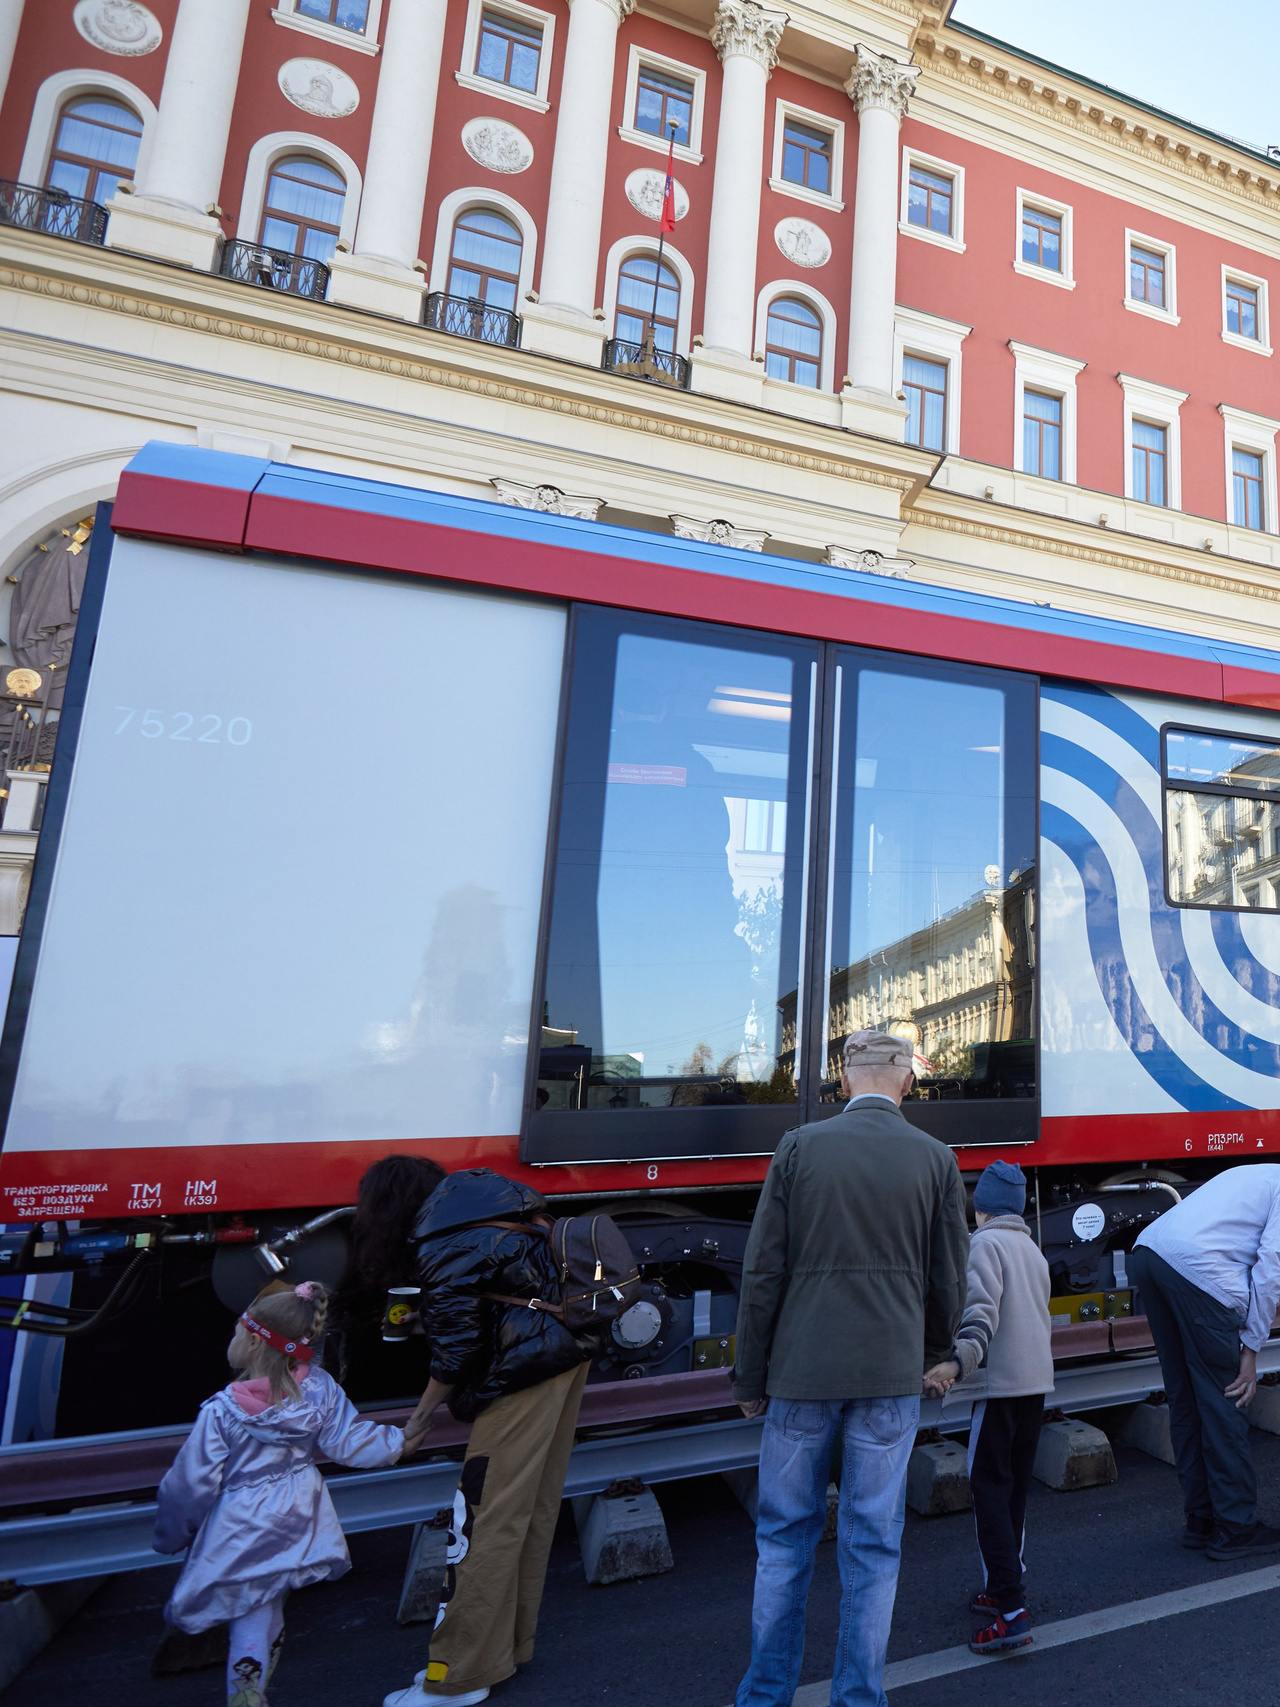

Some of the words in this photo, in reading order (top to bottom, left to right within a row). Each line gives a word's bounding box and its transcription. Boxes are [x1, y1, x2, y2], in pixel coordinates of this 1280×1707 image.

[114, 705, 253, 747] 75220
[1184, 1138, 1193, 1151] 6
[647, 1164, 658, 1180] 8
[3, 1183, 108, 1196] ТРАНСПОРТИРОВКА
[131, 1183, 161, 1198] ТМ
[185, 1180, 217, 1195] НМ
[13, 1197, 36, 1206] БЕЗ
[42, 1194, 94, 1205] ВОЗДУХА
[127, 1199, 162, 1209] (К37)
[184, 1196, 218, 1206] (К39)
[17, 1205, 85, 1217] ЗАПРЕЩЕНА
